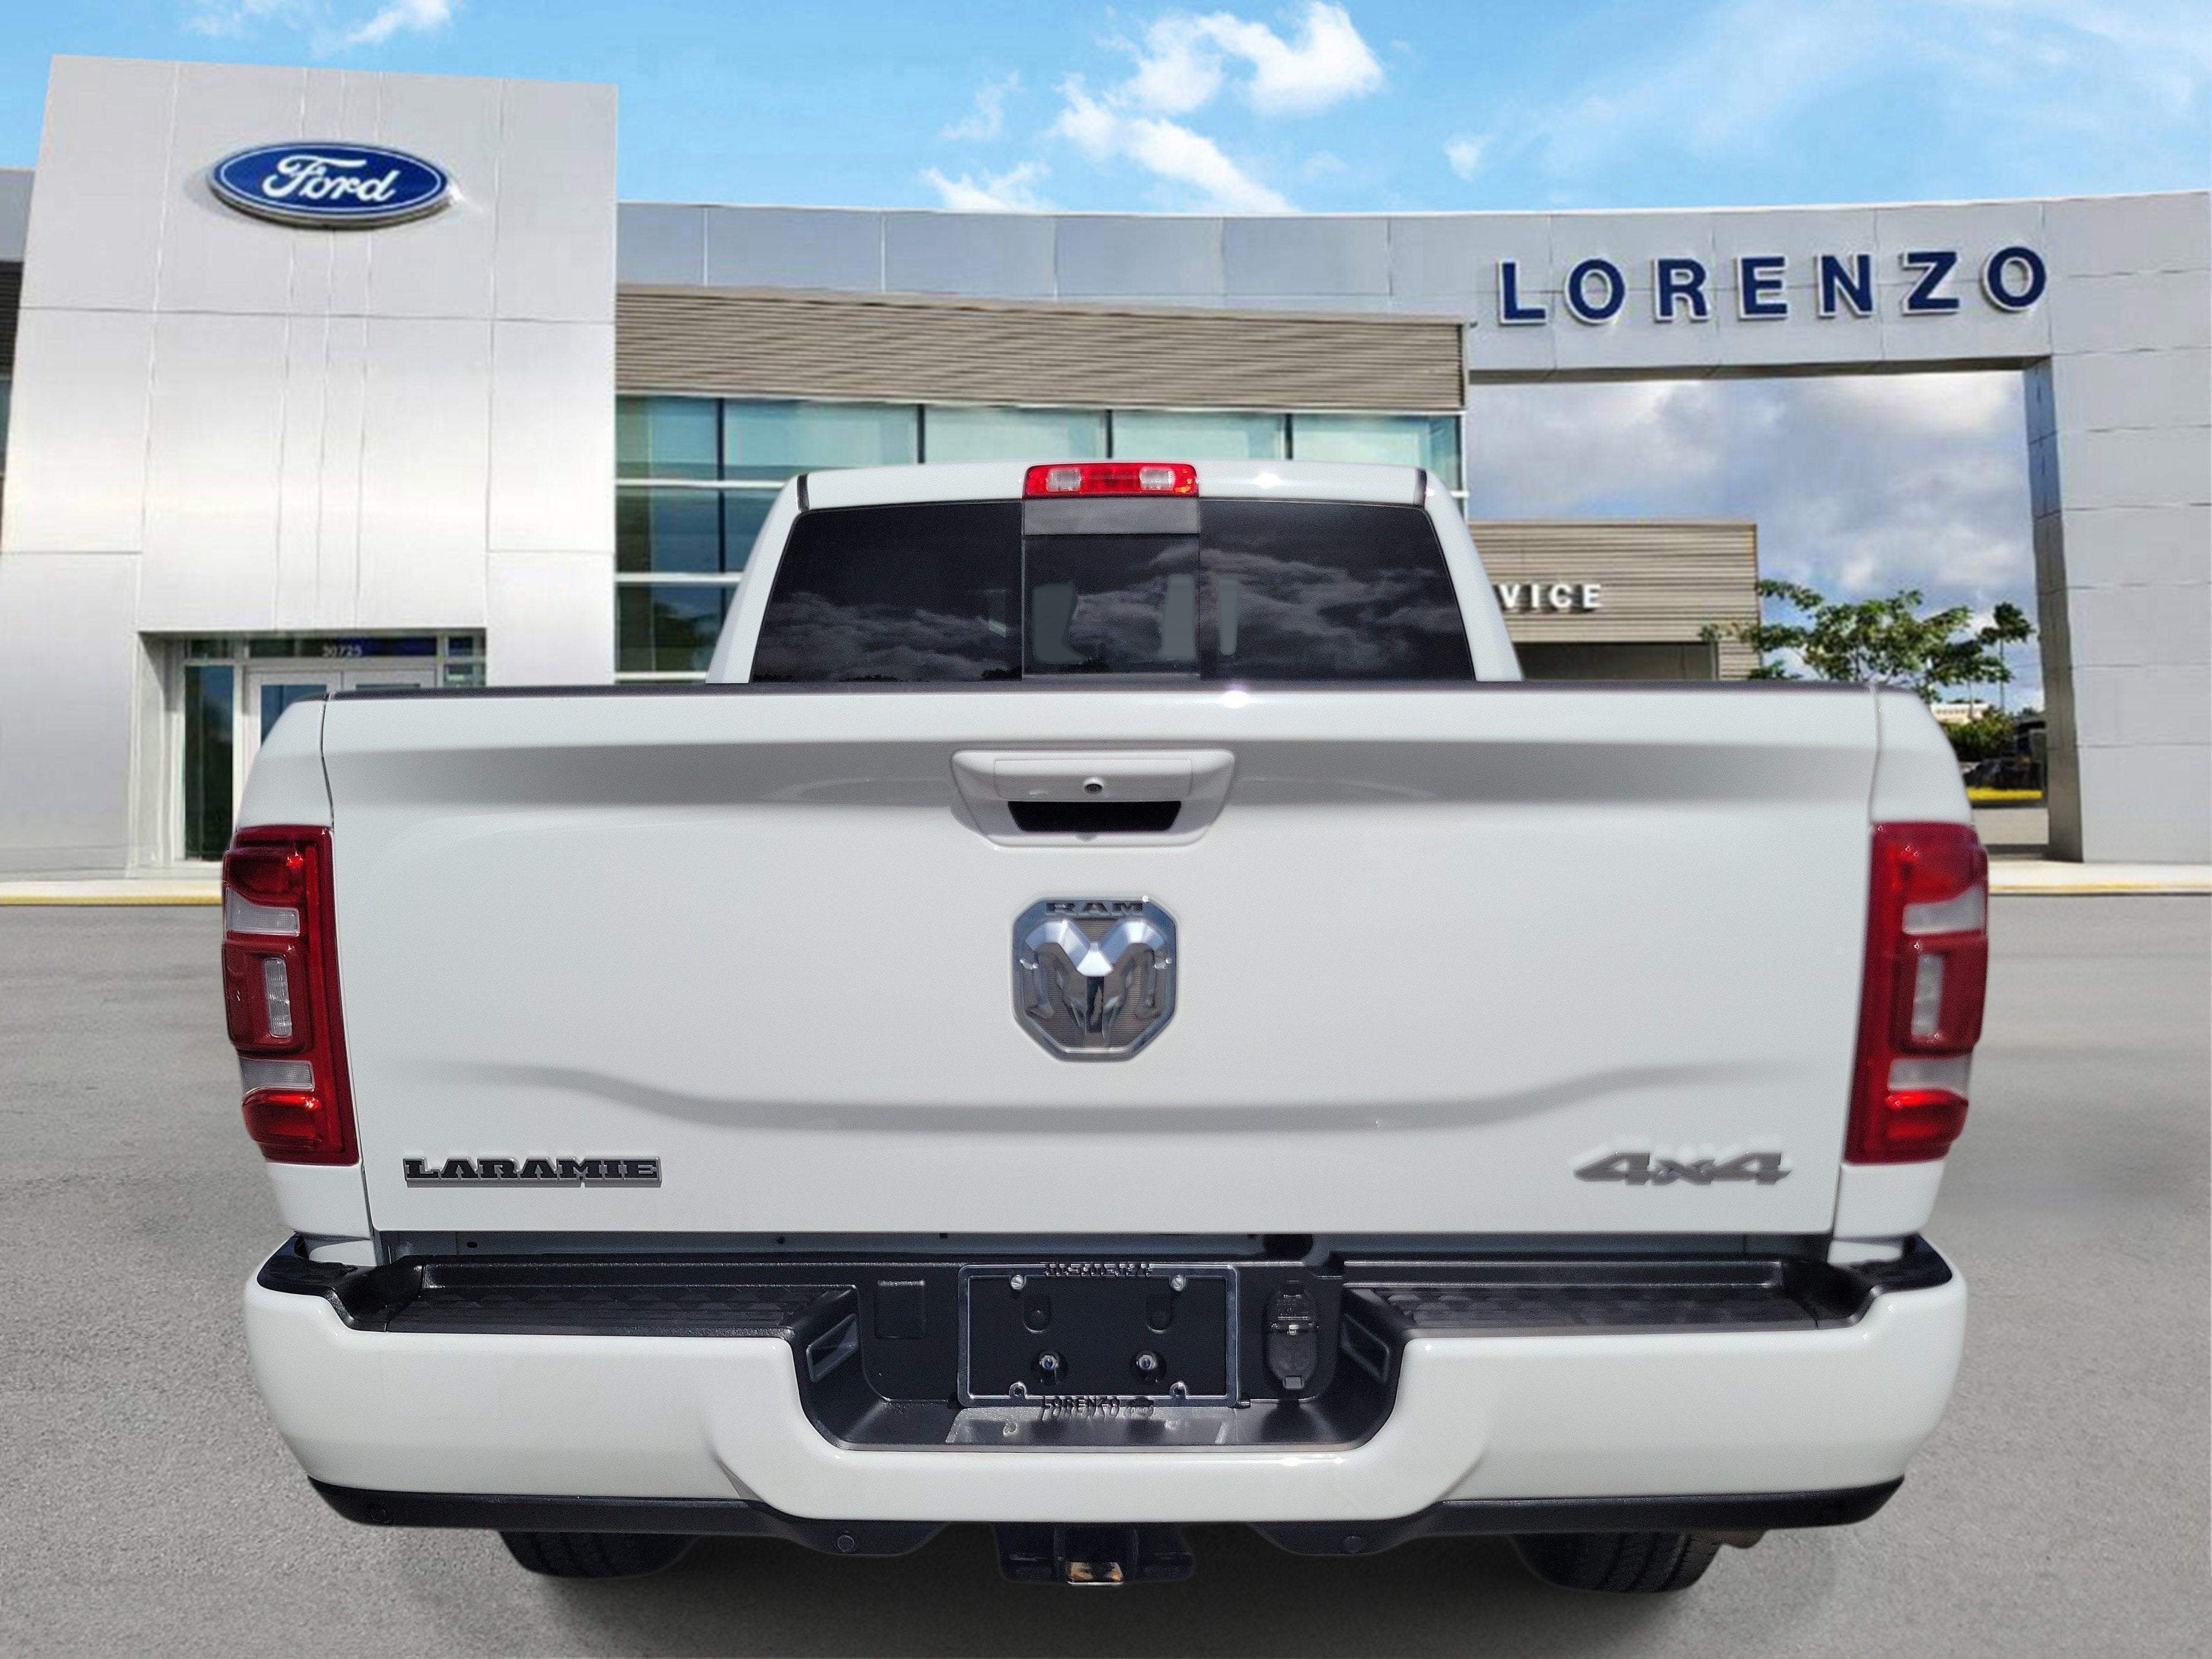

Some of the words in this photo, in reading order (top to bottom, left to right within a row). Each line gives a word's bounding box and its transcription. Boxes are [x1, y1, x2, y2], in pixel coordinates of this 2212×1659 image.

[262, 154, 401, 202] Ford
[1498, 246, 2047, 325] LORENZO
[1045, 901, 1143, 916] RAM
[403, 1157, 662, 1187] LARAMIE
